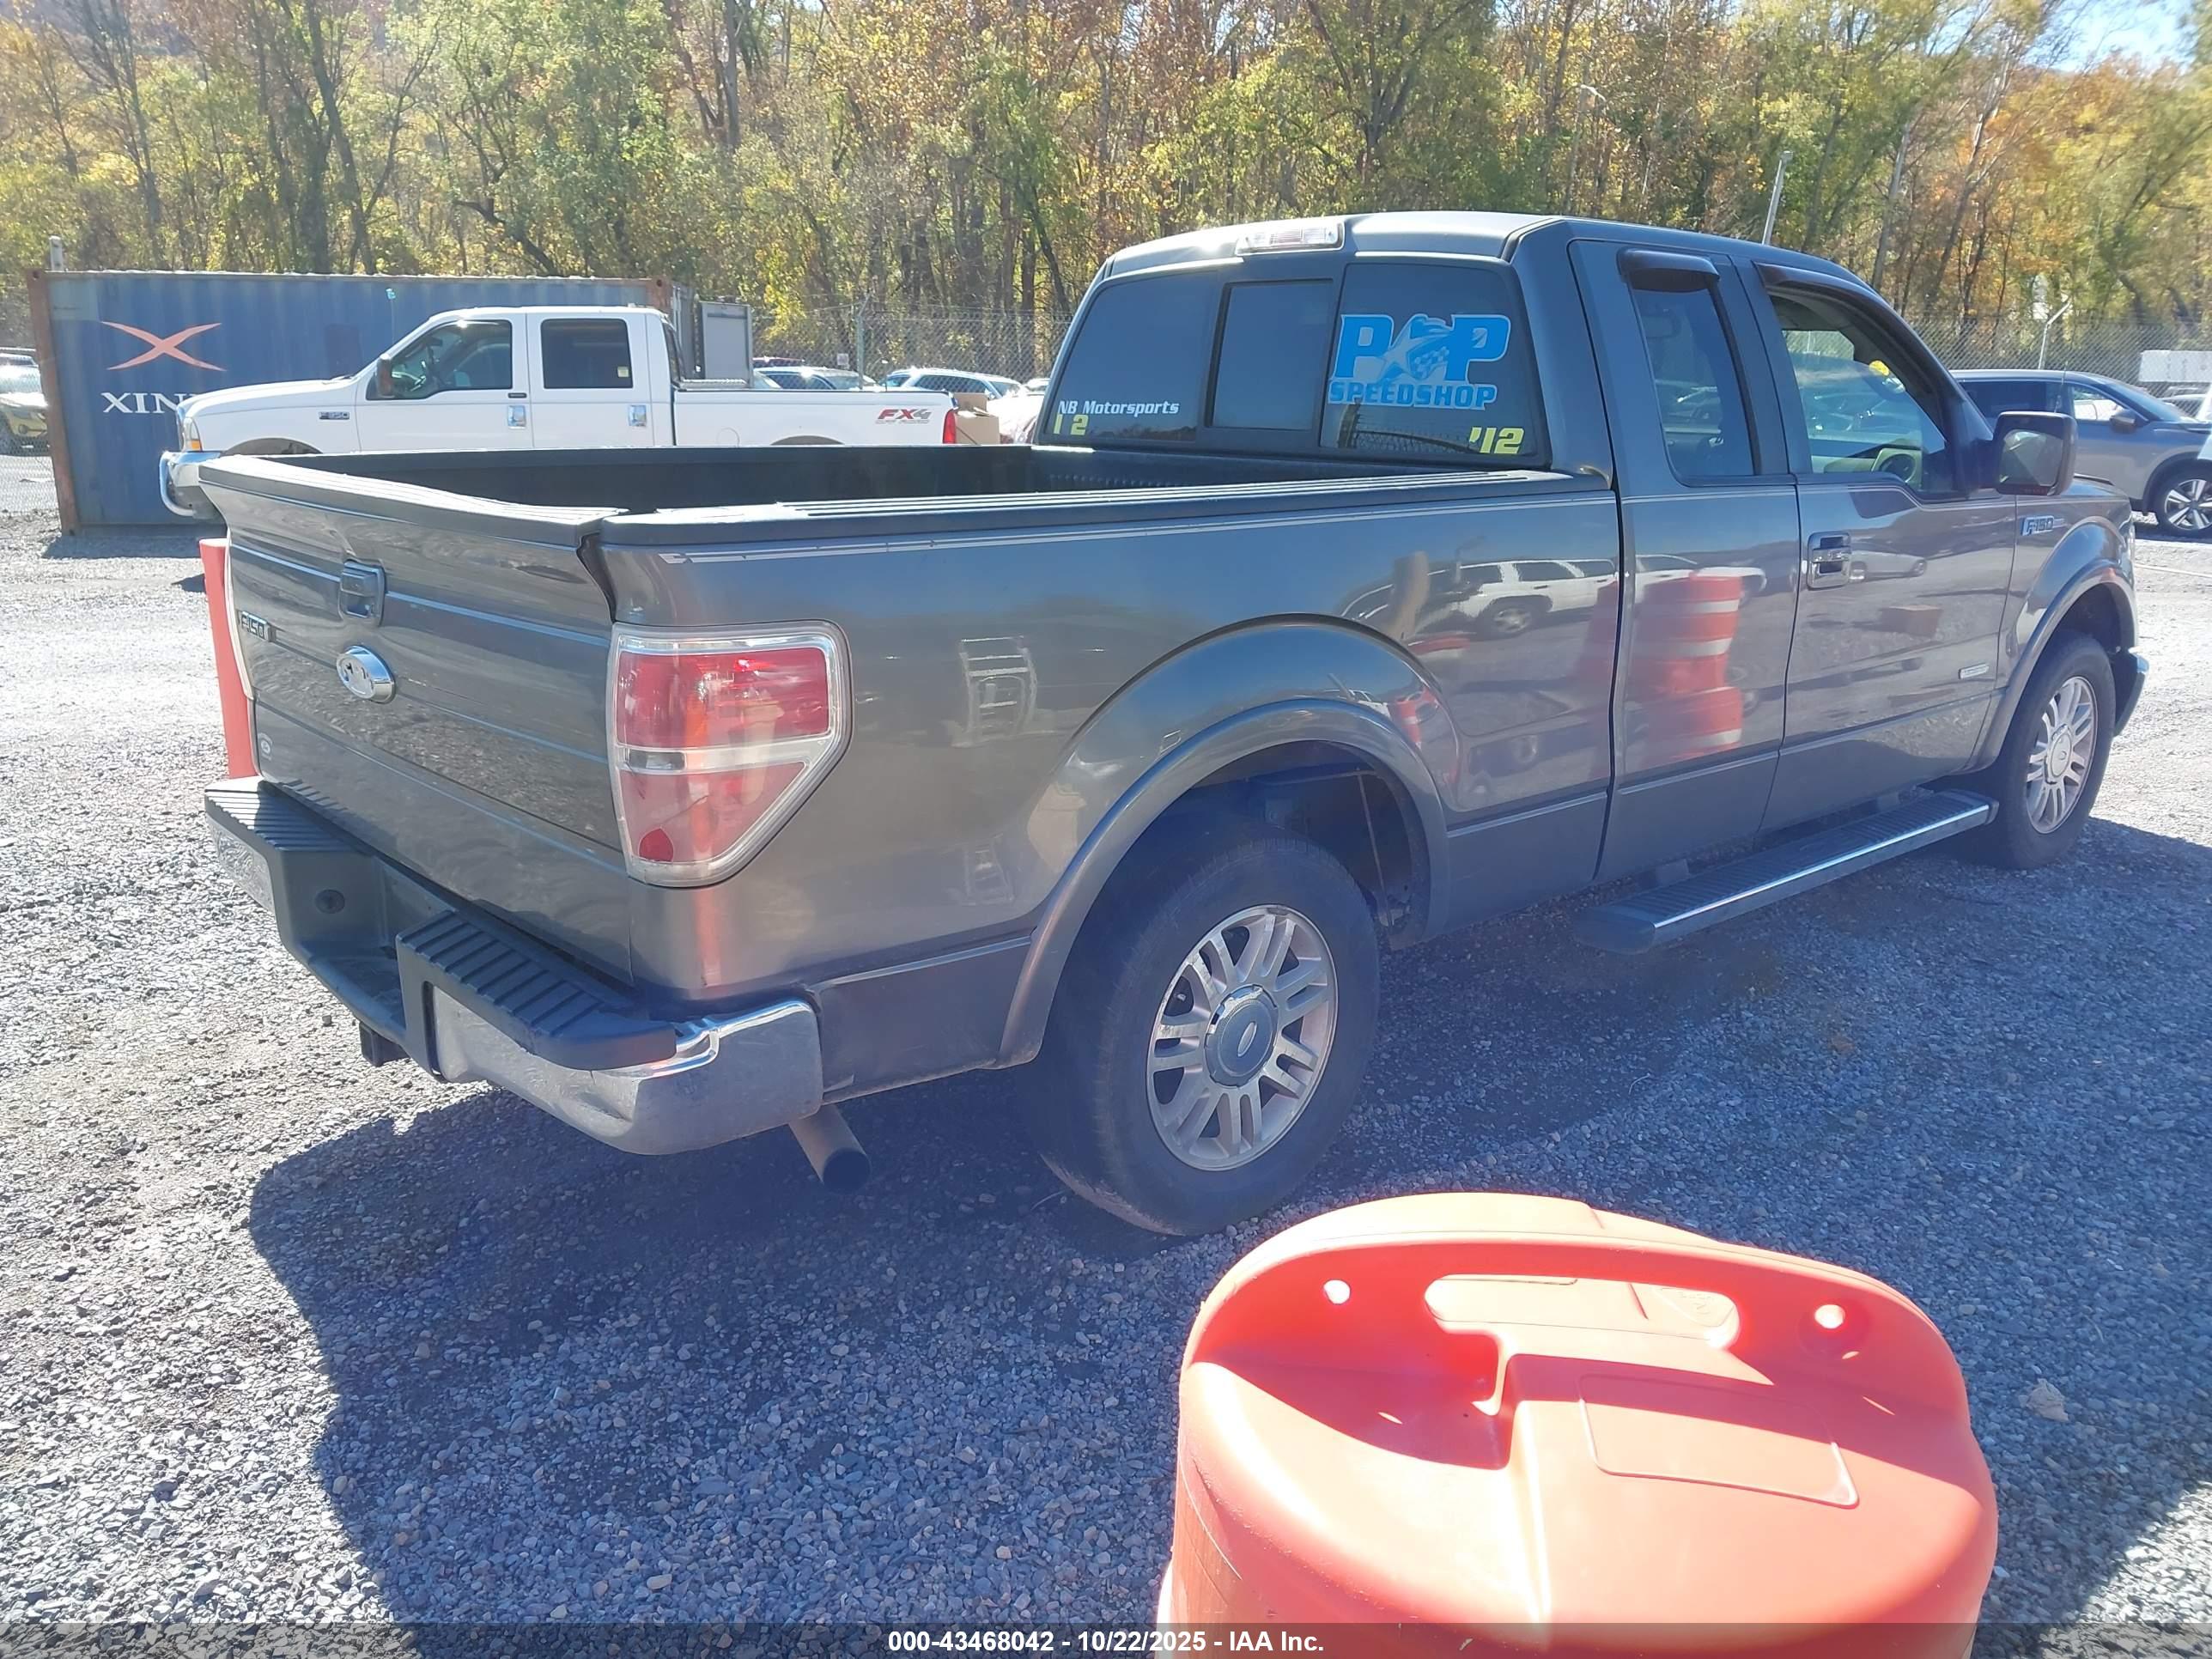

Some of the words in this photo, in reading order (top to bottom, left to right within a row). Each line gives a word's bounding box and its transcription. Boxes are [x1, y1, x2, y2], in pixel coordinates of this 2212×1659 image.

[100, 392, 198, 414] XIN
[1328, 380, 1498, 410] SPEEDSHOP
[878, 409, 932, 419] FX4
[1058, 400, 1078, 415] NB
[1083, 400, 1180, 417] Motorsports
